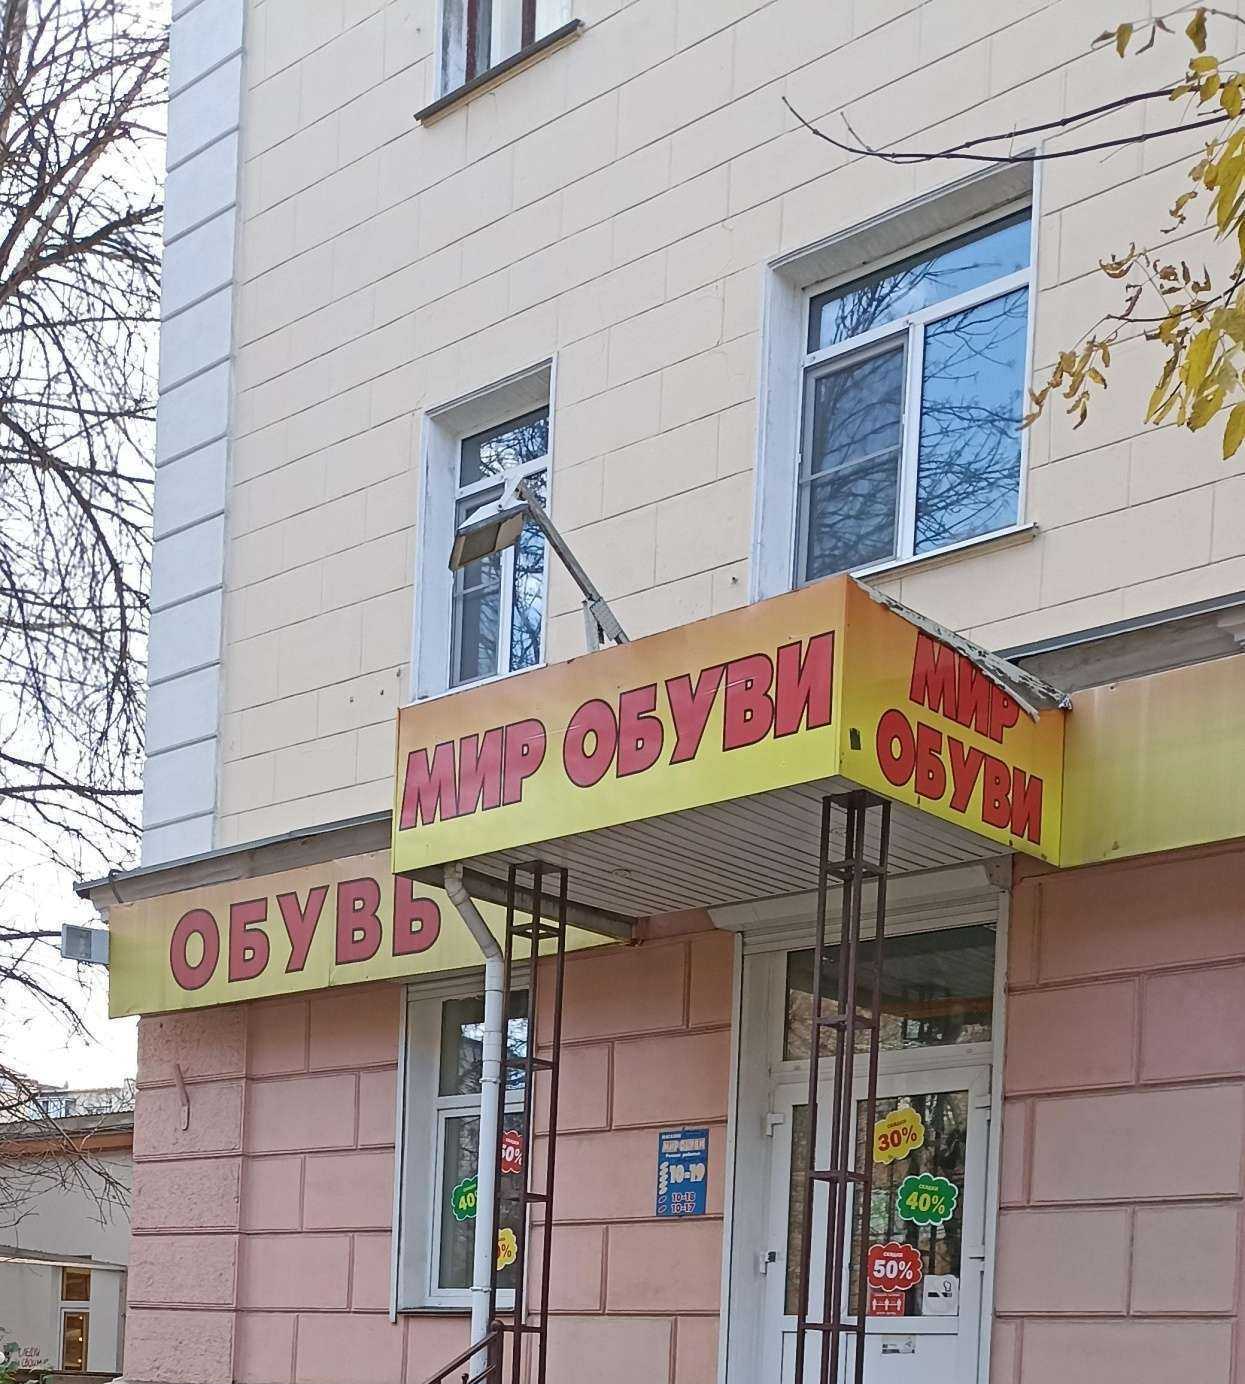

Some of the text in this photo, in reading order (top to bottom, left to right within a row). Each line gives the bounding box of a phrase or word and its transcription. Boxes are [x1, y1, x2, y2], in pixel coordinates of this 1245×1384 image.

[909, 631, 1020, 744] МИР
[398, 630, 837, 831] МИР ОБУВИ
[876, 708, 1044, 846] ОБУВИ
[169, 873, 442, 992] ОБУВЬ
[878, 1125, 917, 1152] 30%
[458, 1191, 478, 1211] 40
[905, 1191, 945, 1215] 40%
[873, 1259, 914, 1280] 50%
